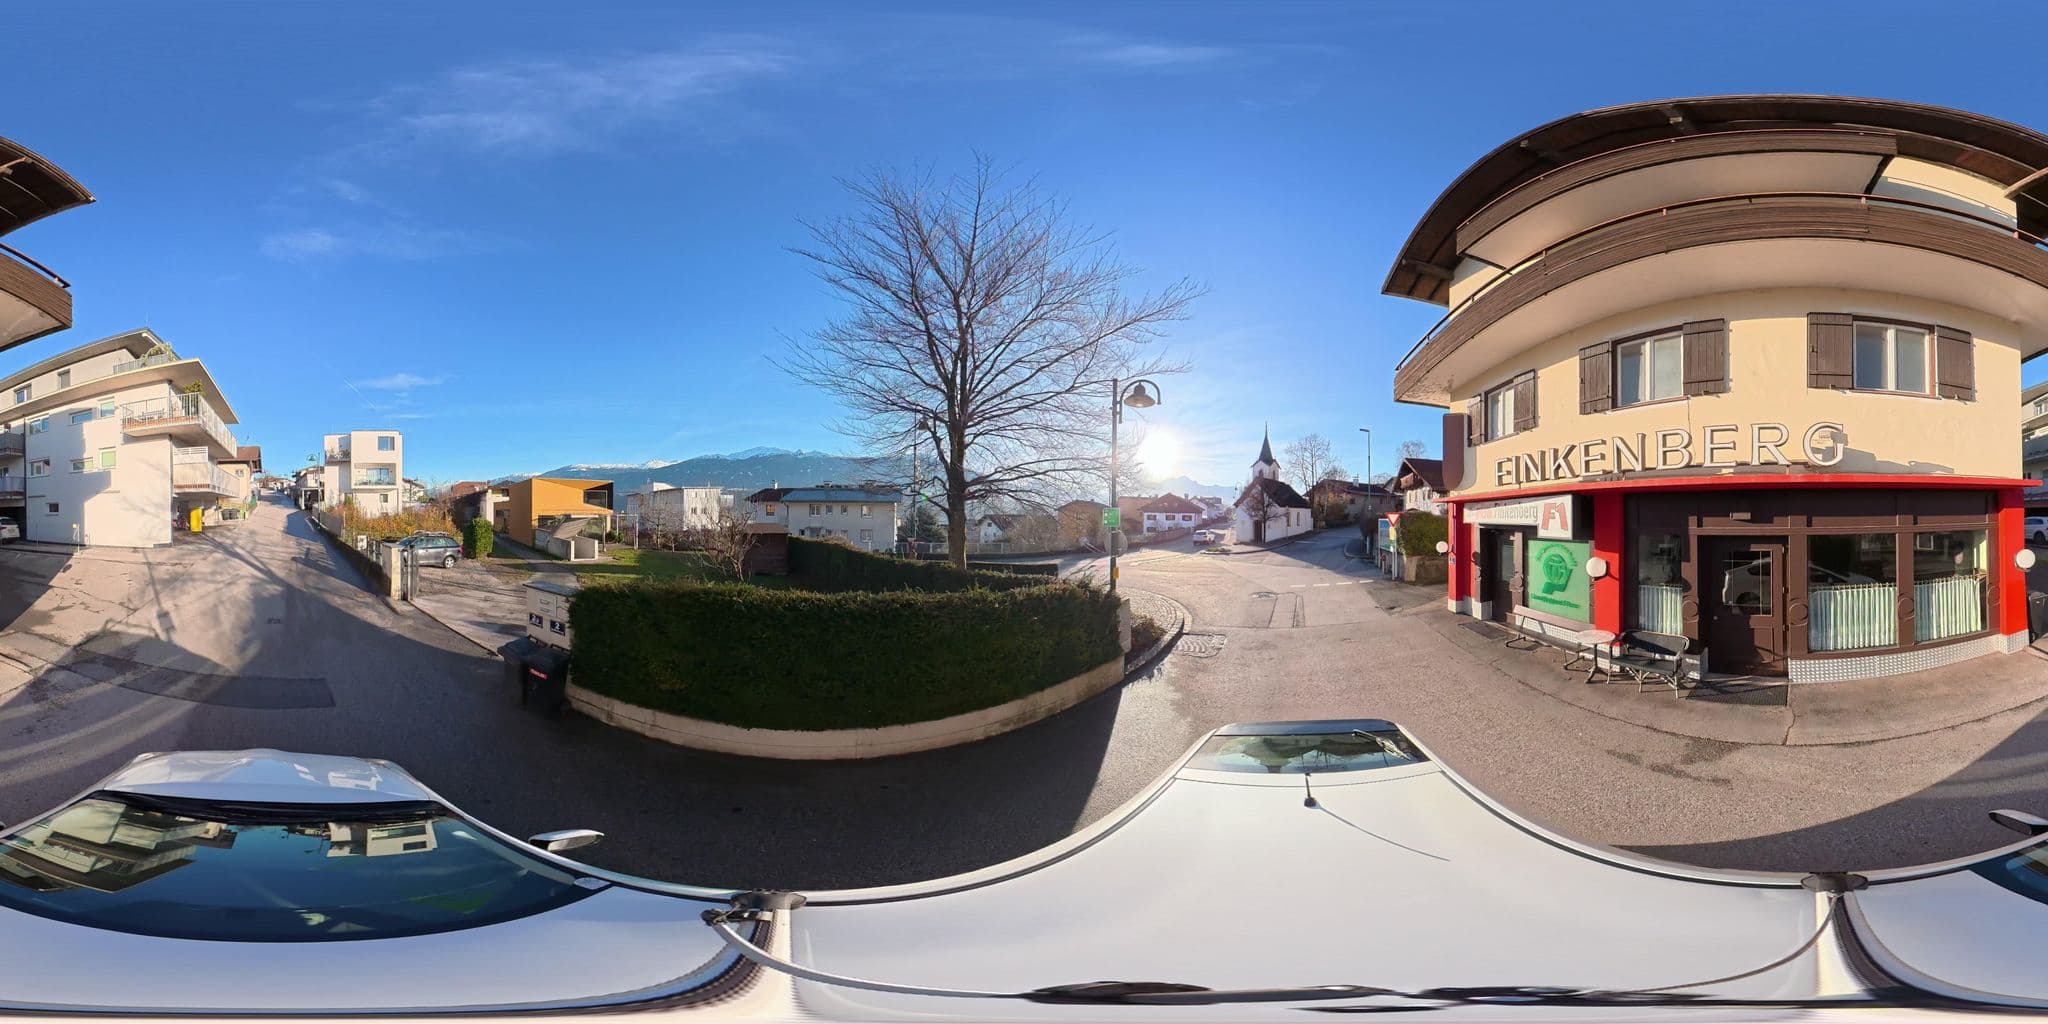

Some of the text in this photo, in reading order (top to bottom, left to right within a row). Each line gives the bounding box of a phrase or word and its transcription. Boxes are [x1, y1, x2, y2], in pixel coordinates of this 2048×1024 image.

[1494, 421, 1845, 487] FINKENBERG
[1541, 502, 1568, 531] F1
[554, 622, 561, 630] 2
